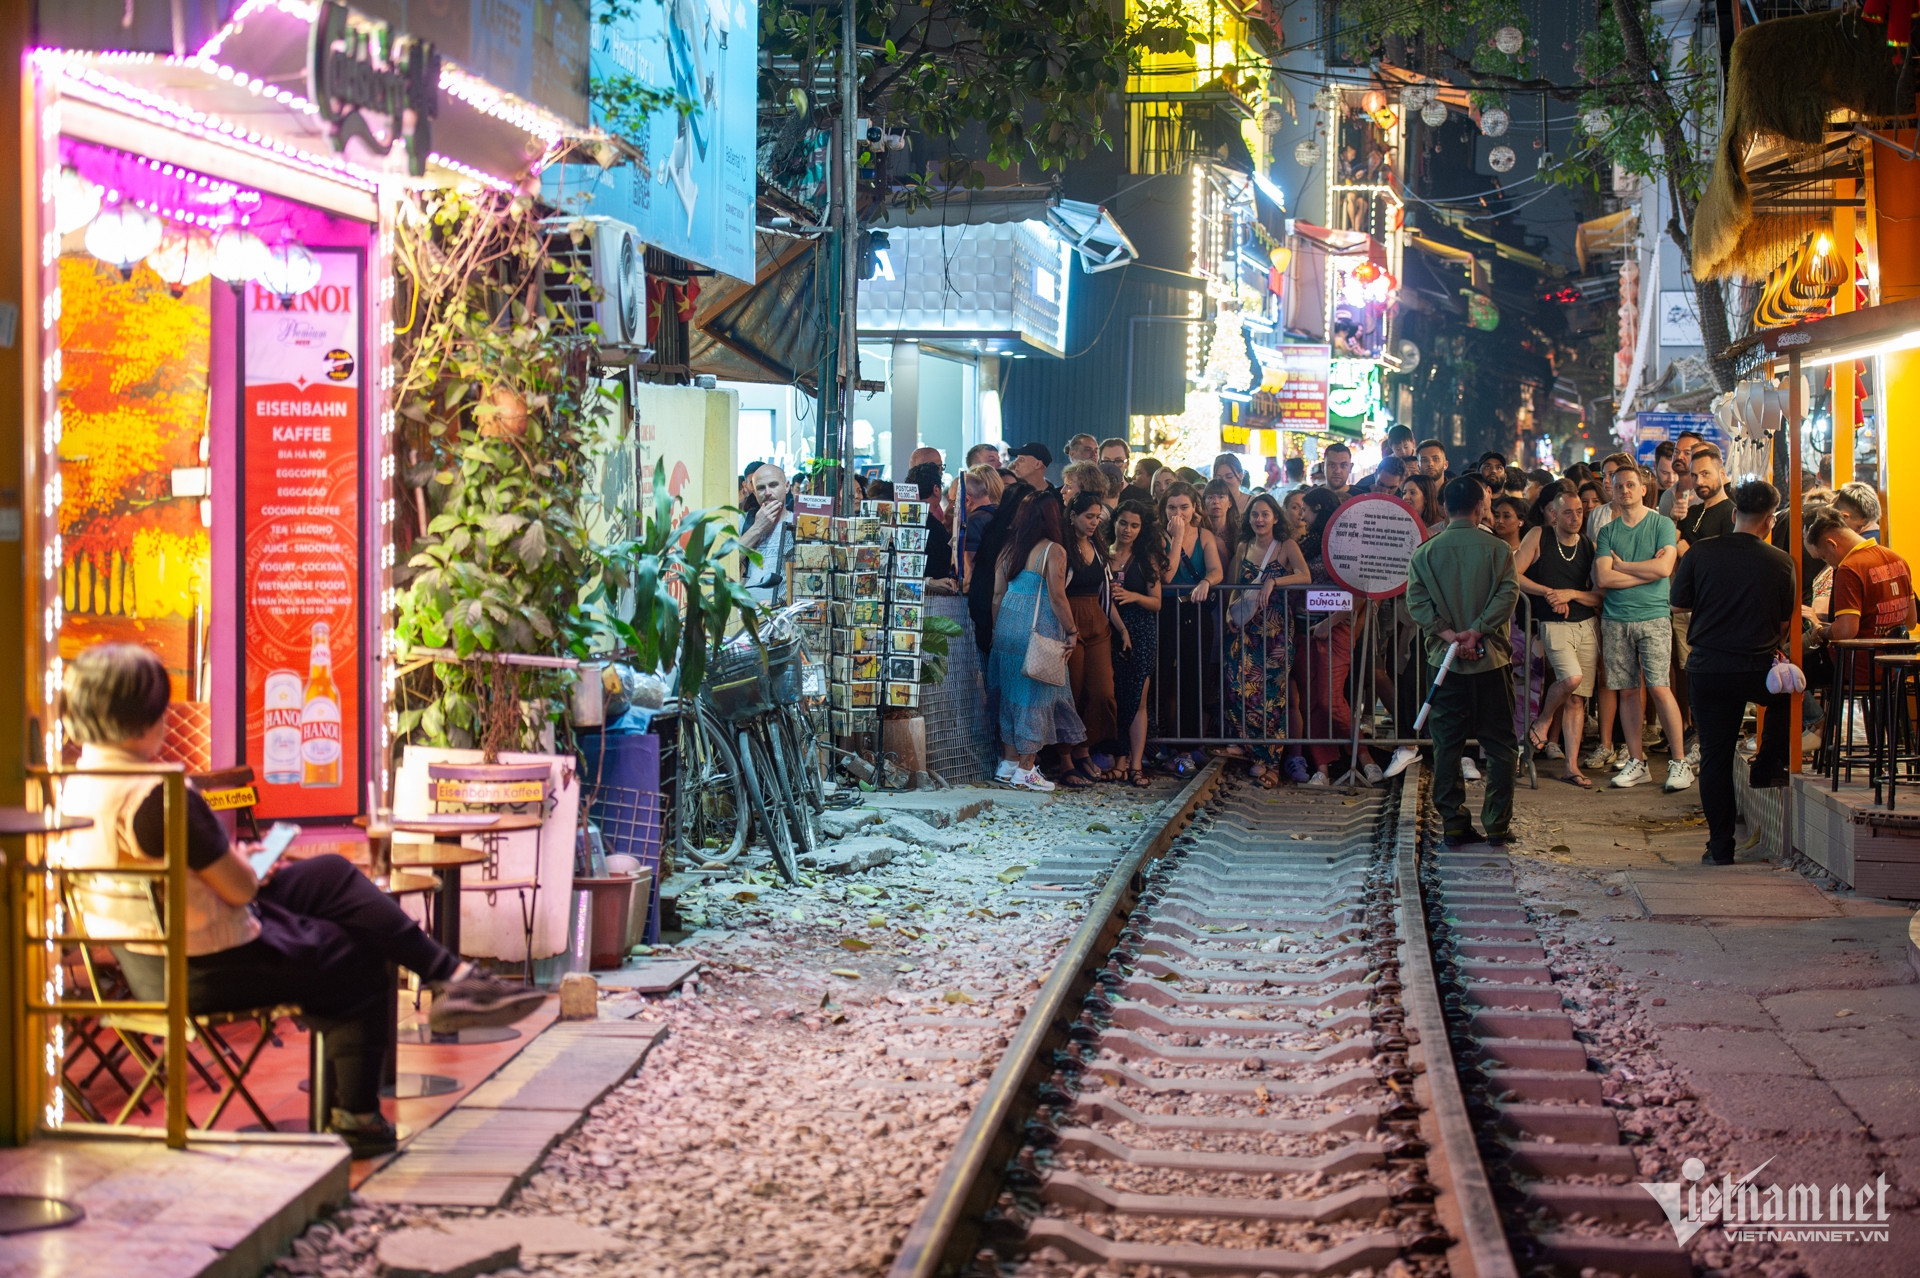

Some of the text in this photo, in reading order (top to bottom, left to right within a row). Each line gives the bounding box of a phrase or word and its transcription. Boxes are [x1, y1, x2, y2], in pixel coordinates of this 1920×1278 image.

[612, 28, 636, 76] Hanoi
[256, 400, 347, 417] EISENBAHN
[272, 426, 331, 442] KAFFEE
[278, 450, 292, 459] BIA
[309, 448, 326, 460] NỘI
[276, 469, 327, 478] EGGCOFFEE
[277, 487, 327, 497] EGGCACAO
[261, 506, 340, 516] COCONUT COFFEE
[263, 544, 288, 553] JUICE
[294, 544, 340, 553] SMOOTHIE
[259, 562, 296, 571] YOGURT
[302, 562, 344, 571] COCKTAIL
[258, 581, 346, 590] VIETNAMESE FOODS
[1890, 582, 1899, 596] TO
[303, 722, 339, 740] HANOI
[226, 790, 254, 806] Kaffee
[439, 785, 540, 799] Eisenbahn Kaffee
